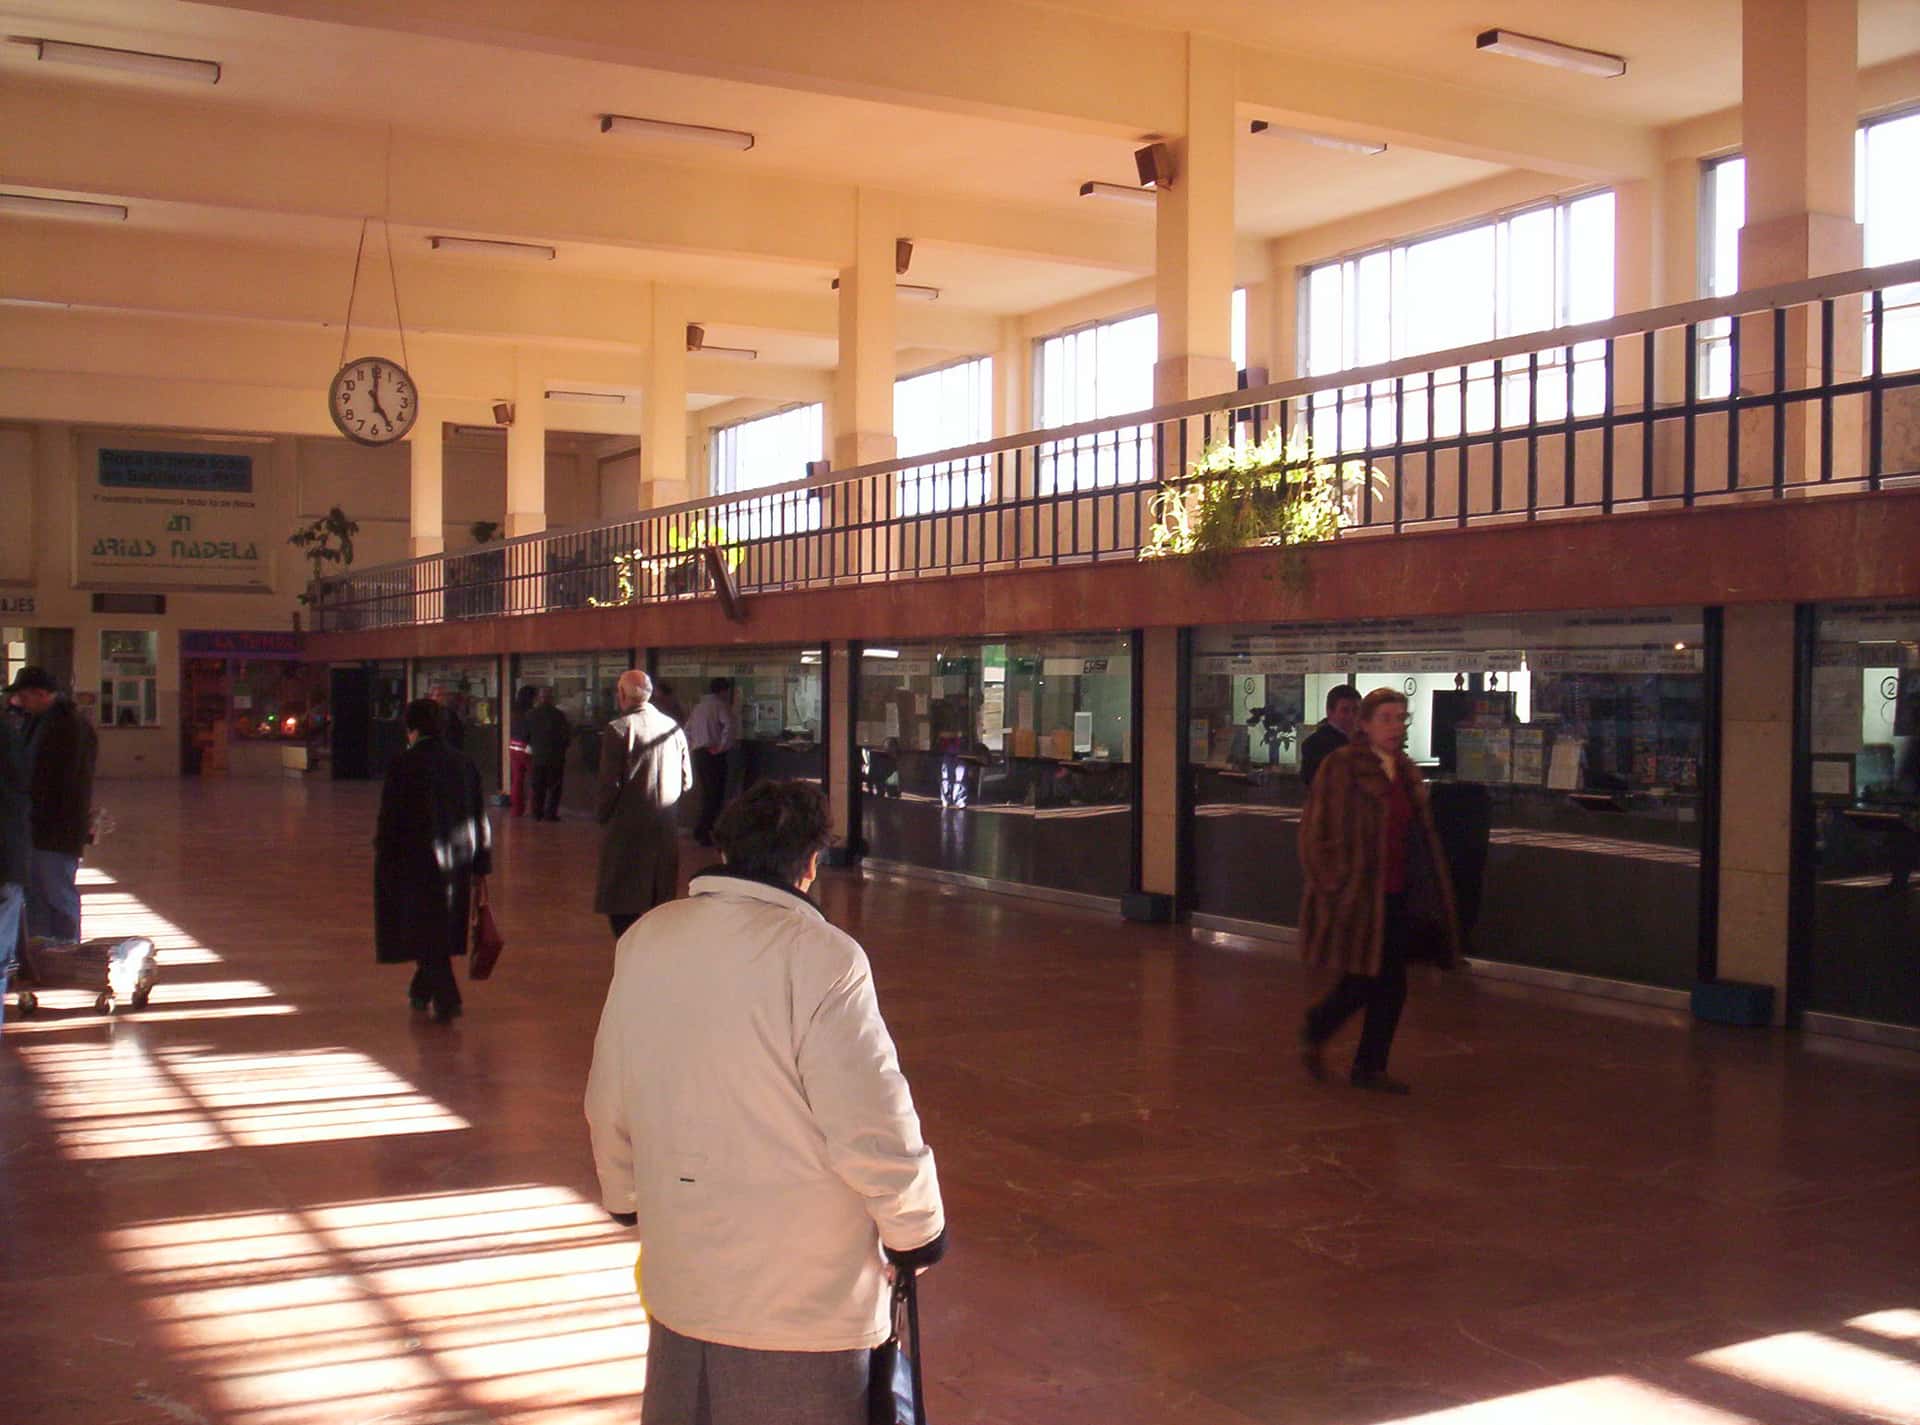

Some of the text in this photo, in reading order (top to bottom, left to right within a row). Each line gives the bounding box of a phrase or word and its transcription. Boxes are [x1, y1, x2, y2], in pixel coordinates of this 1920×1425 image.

[357, 369, 365, 381] 11
[344, 380, 355, 391] 10
[397, 382, 407, 393] 2
[342, 393, 351, 404] 9
[400, 398, 409, 409] 3
[346, 409, 354, 421] 8
[396, 411, 405, 422] 4
[356, 420, 365, 433] 7
[371, 424, 379, 436] 6
[386, 421, 394, 433] 5
[171, 539, 259, 560] NADELA
[1887, 682, 1896, 696] 2
